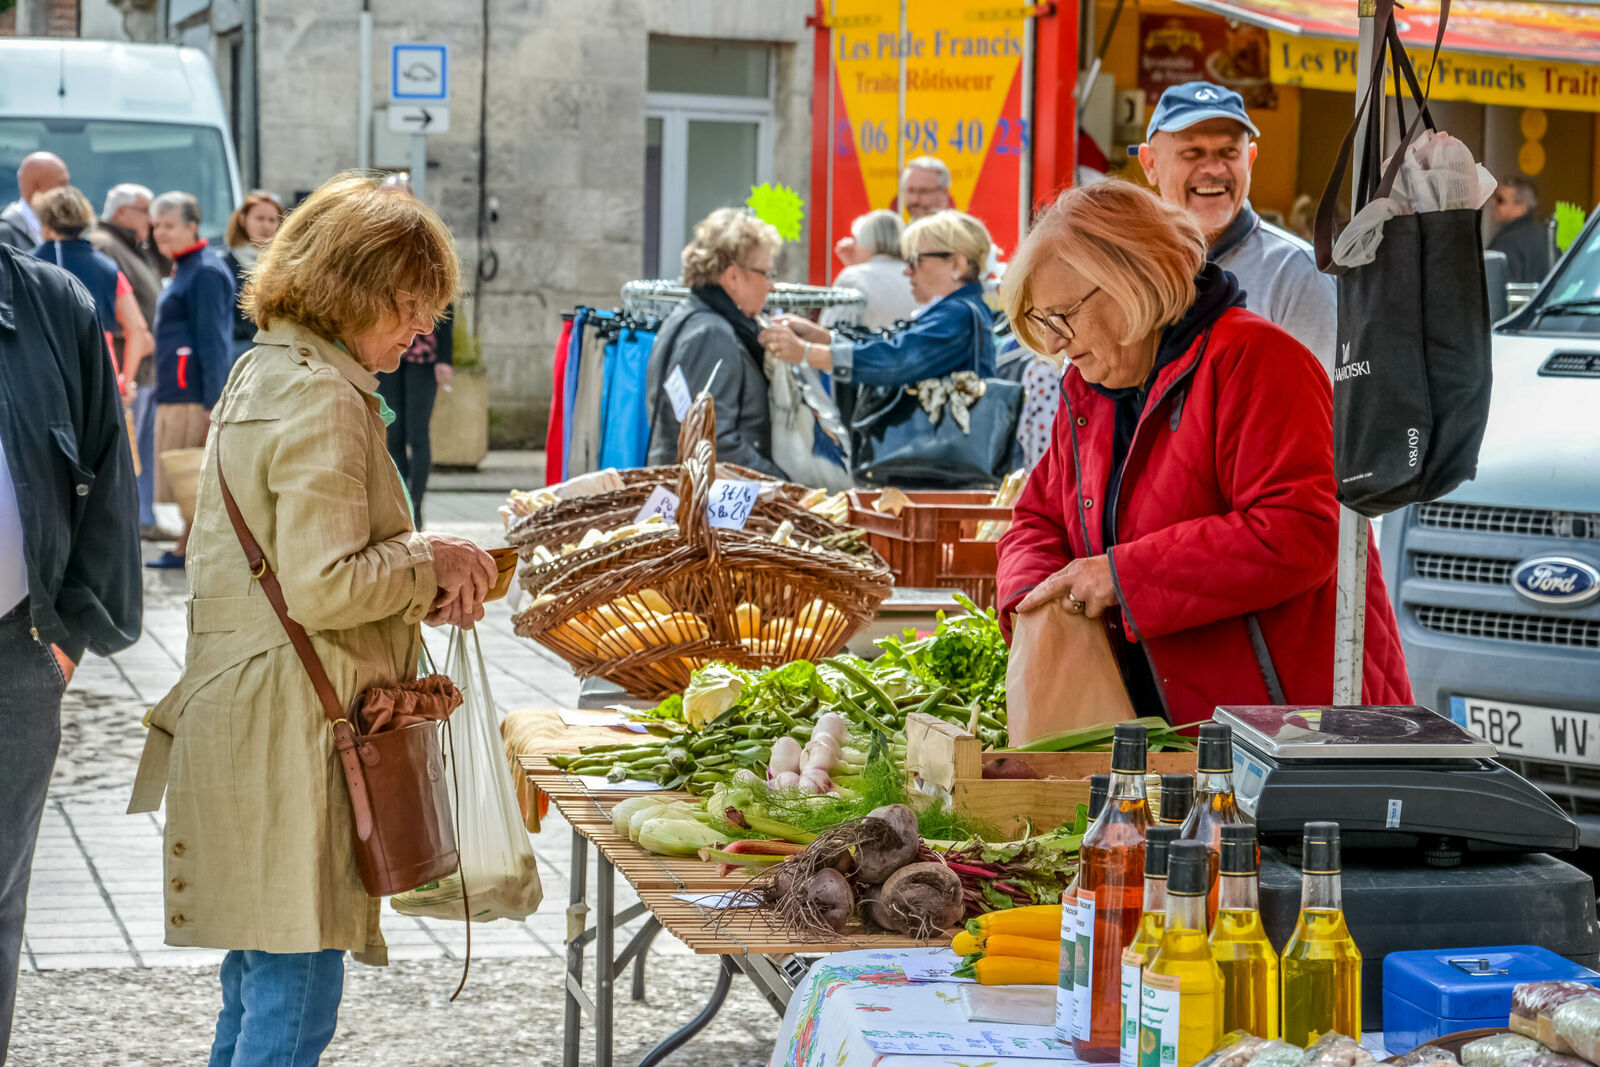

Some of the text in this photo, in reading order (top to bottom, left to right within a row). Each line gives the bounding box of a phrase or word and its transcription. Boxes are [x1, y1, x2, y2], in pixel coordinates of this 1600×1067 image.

[840, 34, 870, 60] Les
[935, 29, 1022, 58] Francis
[1283, 43, 1324, 72] Les
[1436, 57, 1526, 90] Francis
[861, 117, 889, 154] 06
[904, 117, 940, 155] 98
[948, 117, 984, 155] 40
[995, 117, 1031, 156] 23
[1407, 427, 1420, 467] 08/09
[1527, 564, 1579, 593] Ford
[1469, 705, 1588, 757] 582 WV
